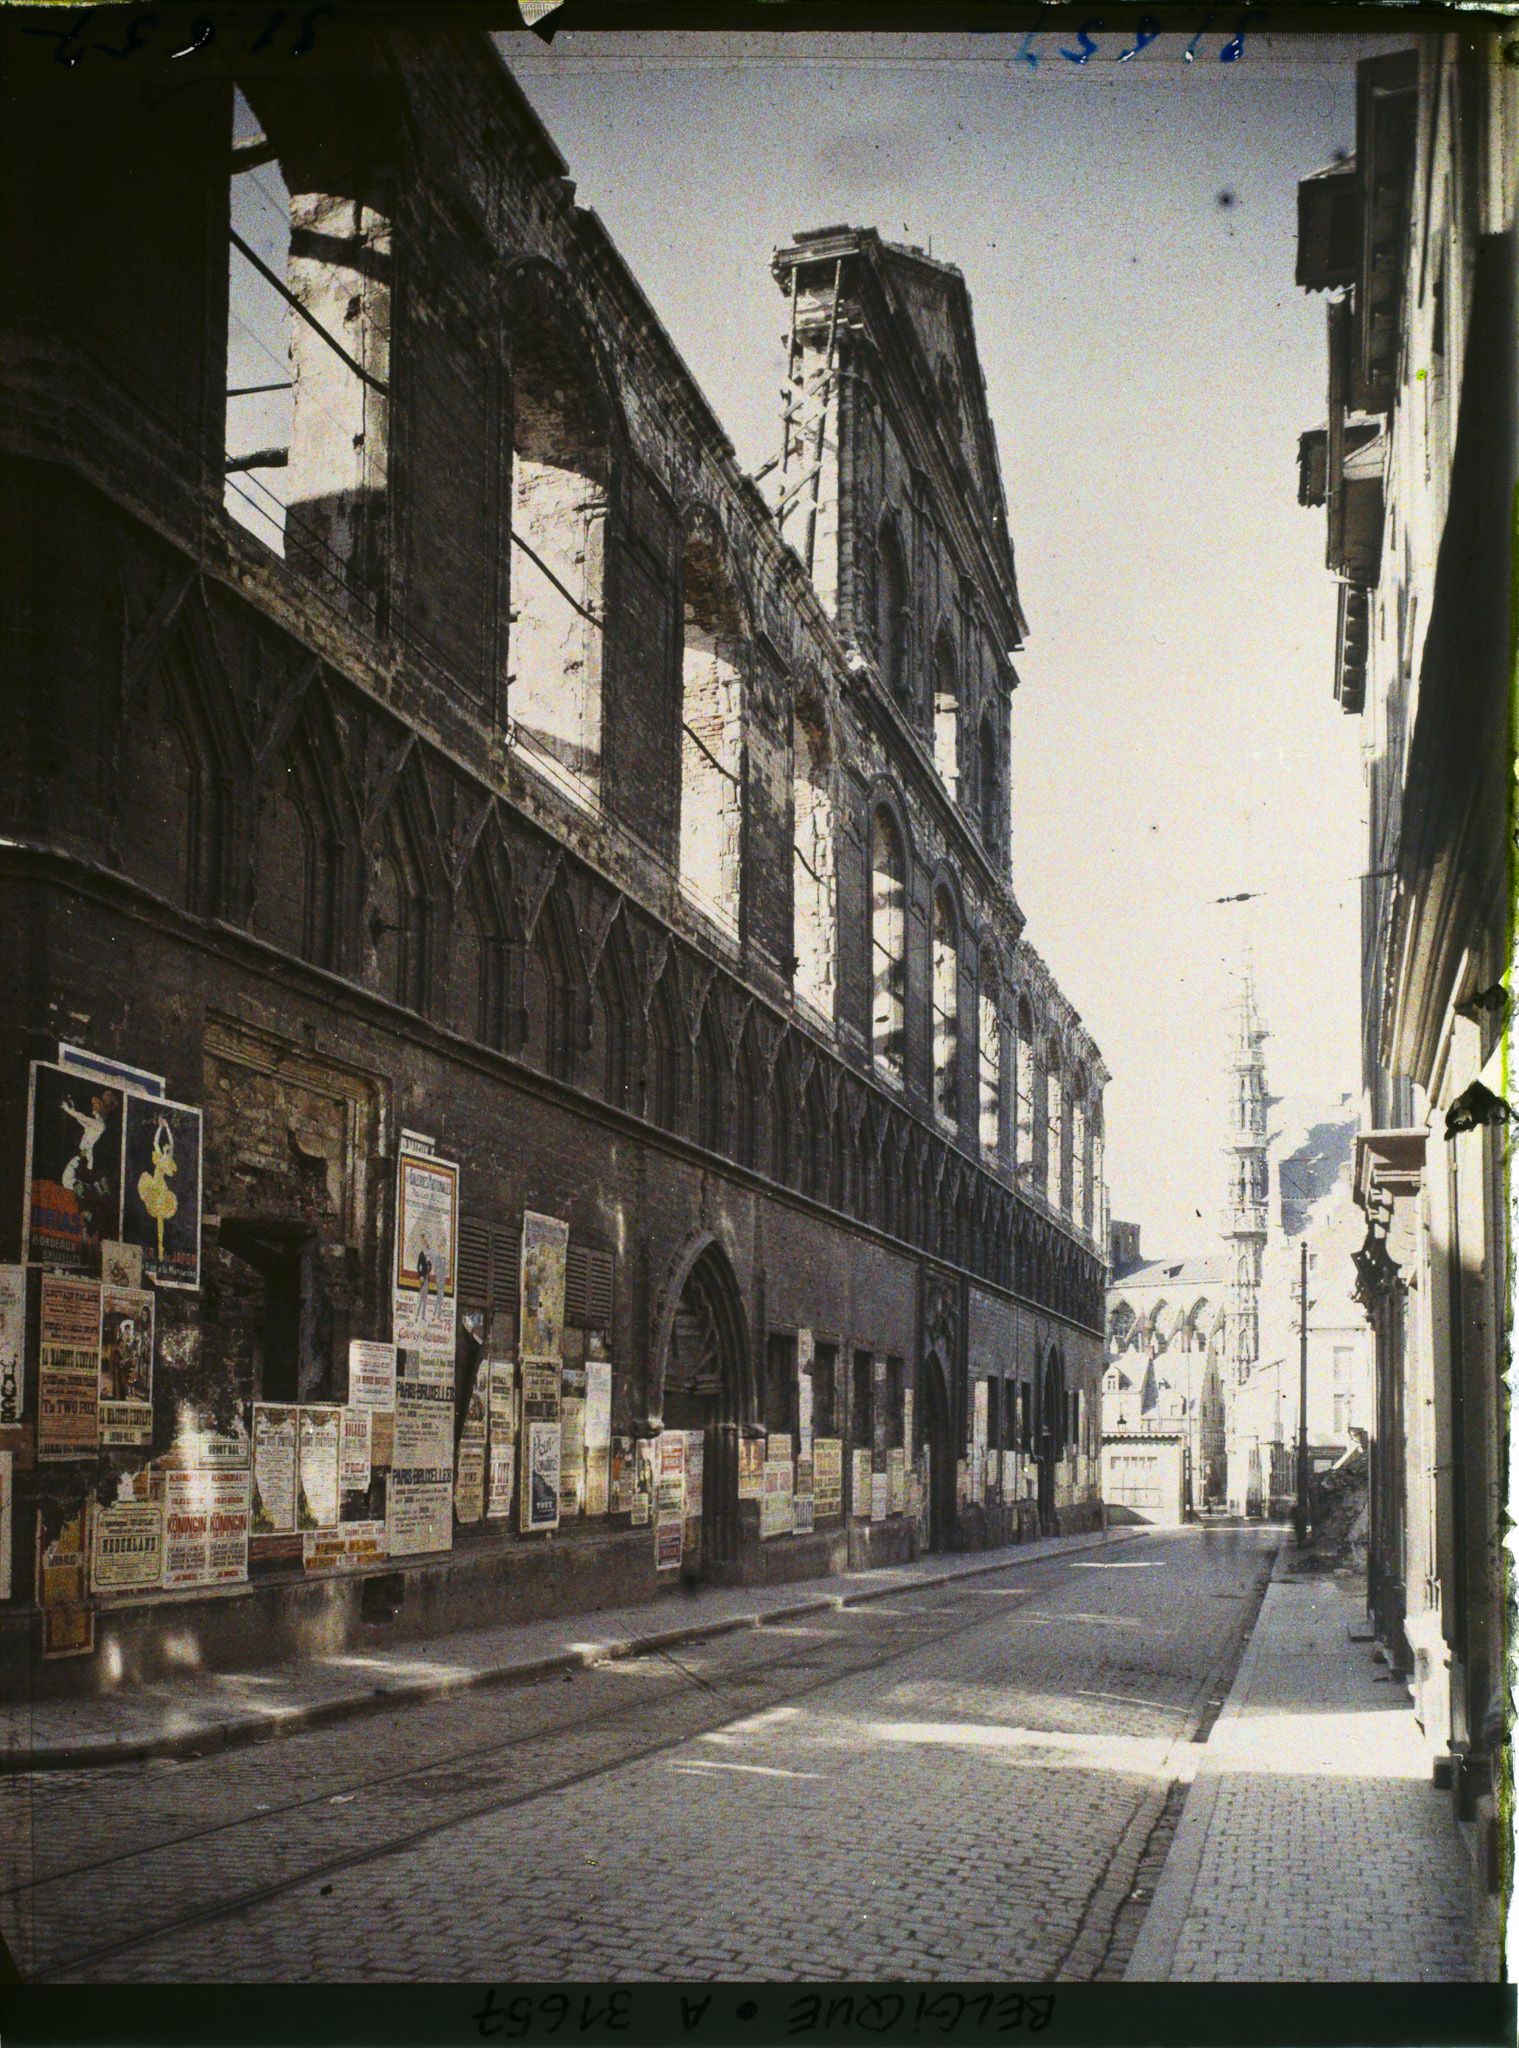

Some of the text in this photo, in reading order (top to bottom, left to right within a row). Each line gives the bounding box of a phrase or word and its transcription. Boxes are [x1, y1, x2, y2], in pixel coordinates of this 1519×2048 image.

[396, 1381, 455, 1402] PARIS-BRUXELLES
[392, 1467, 452, 1486] PARIS-BRUXELLES
[102, 1537, 156, 1553] NEDERLAND
